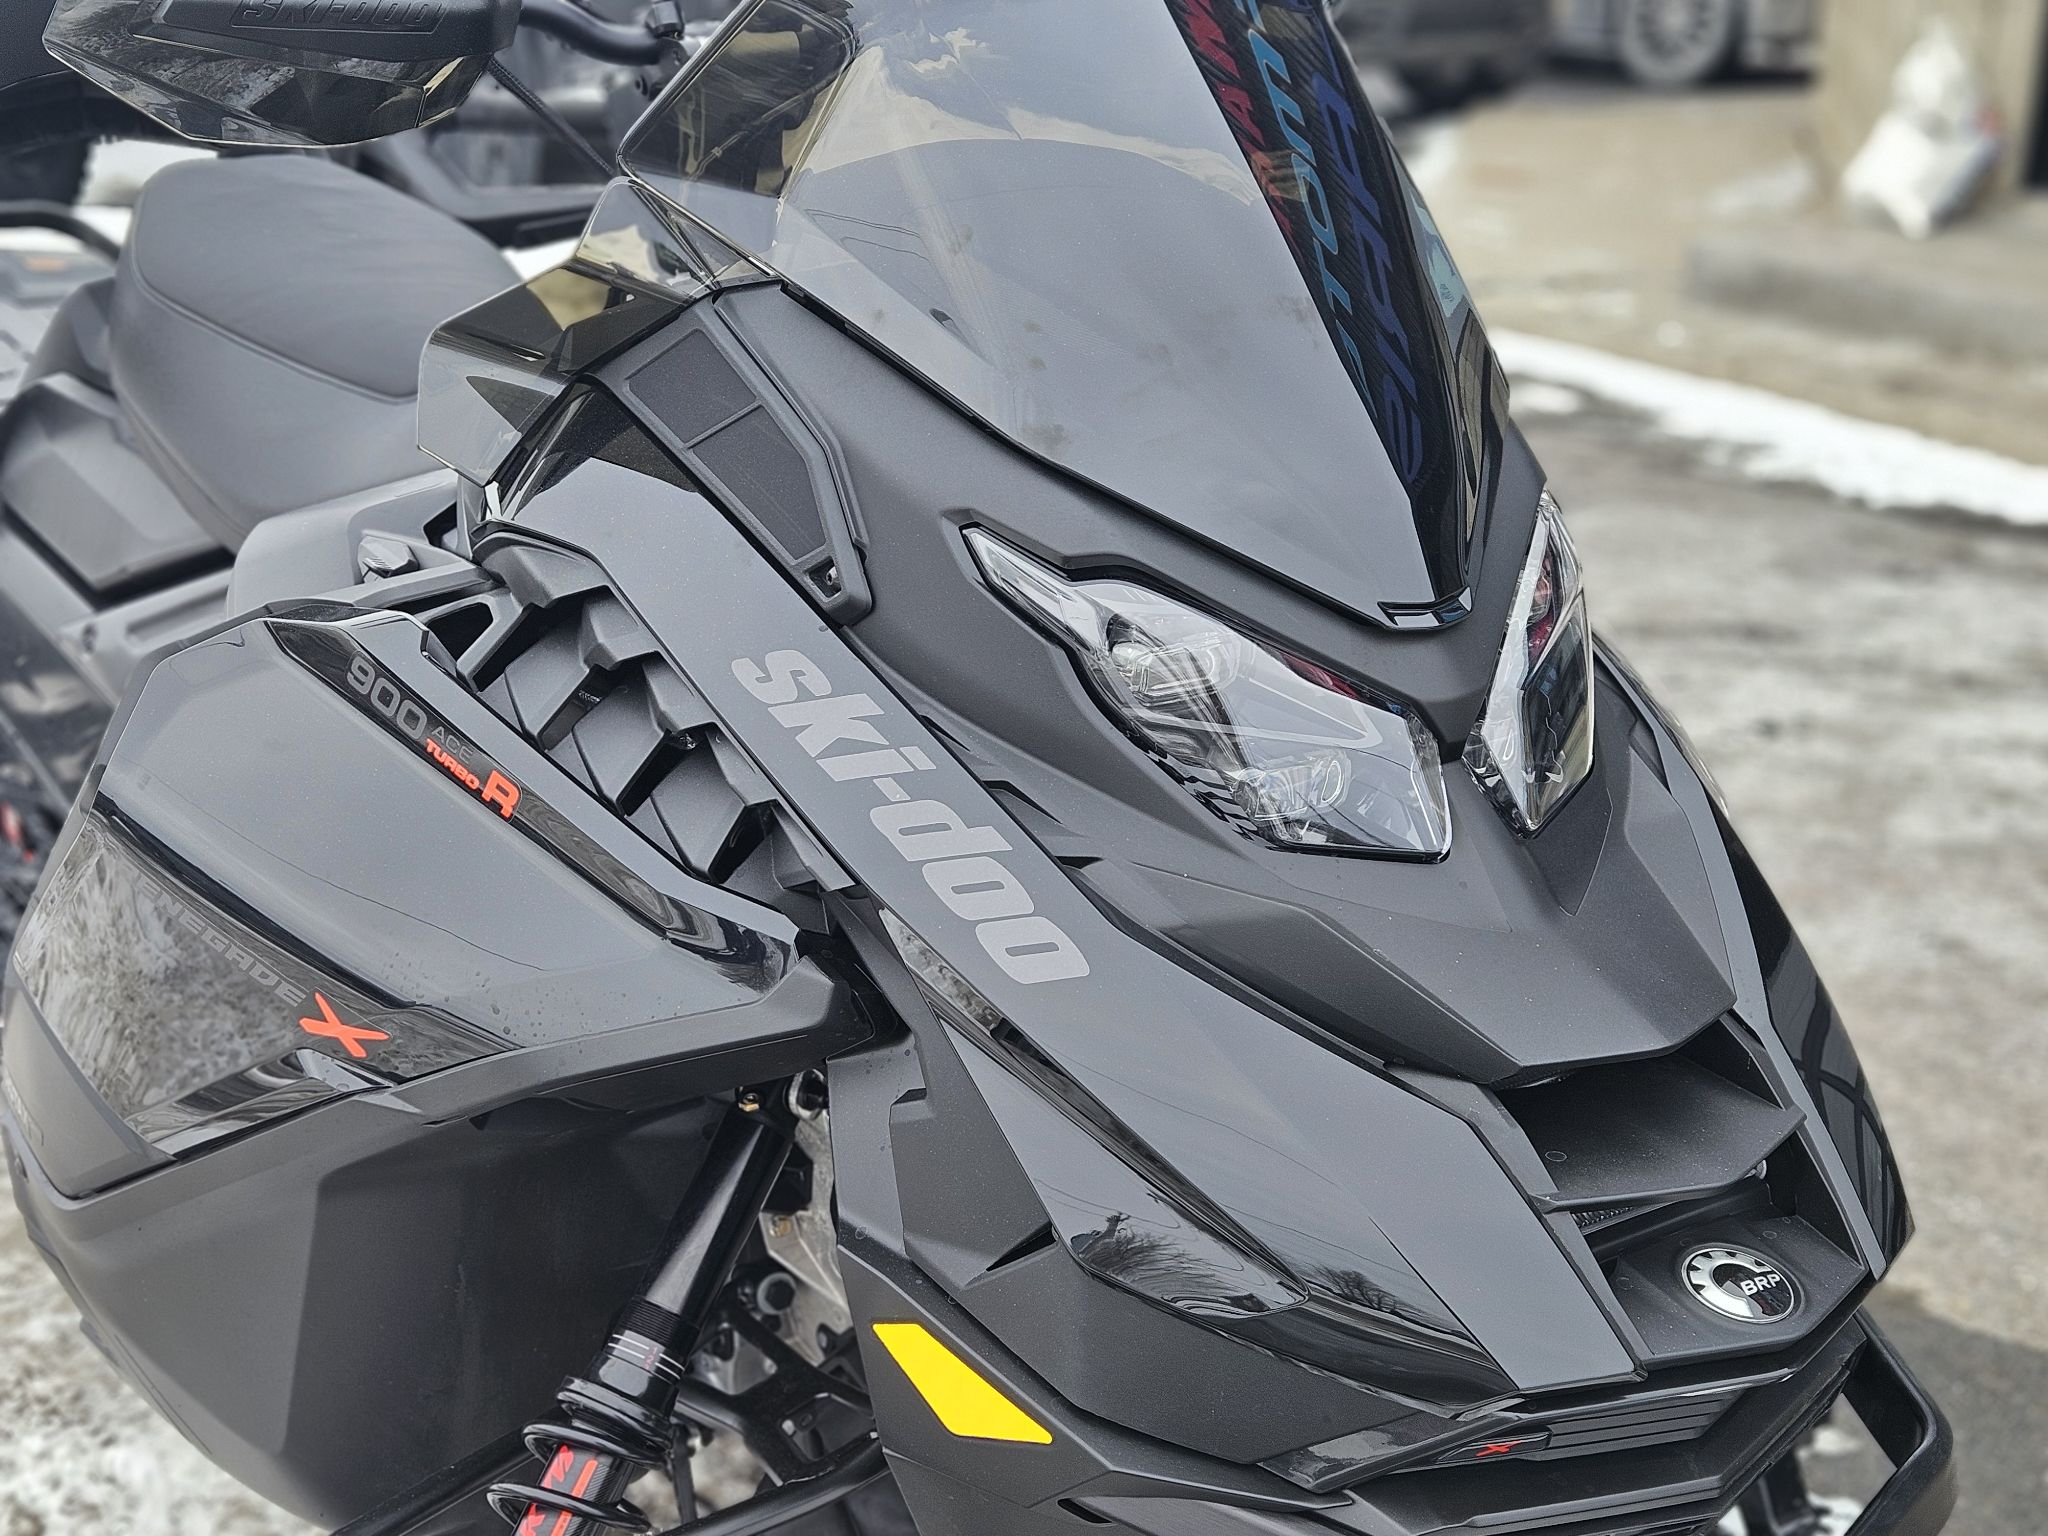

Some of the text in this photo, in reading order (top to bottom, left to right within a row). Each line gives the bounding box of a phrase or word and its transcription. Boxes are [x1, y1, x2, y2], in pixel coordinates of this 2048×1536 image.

[346, 654, 475, 765] 900 ACE
[426, 738, 521, 819] TURBO R
[299, 991, 391, 1059] X
[1740, 1273, 1781, 1297] BRP
